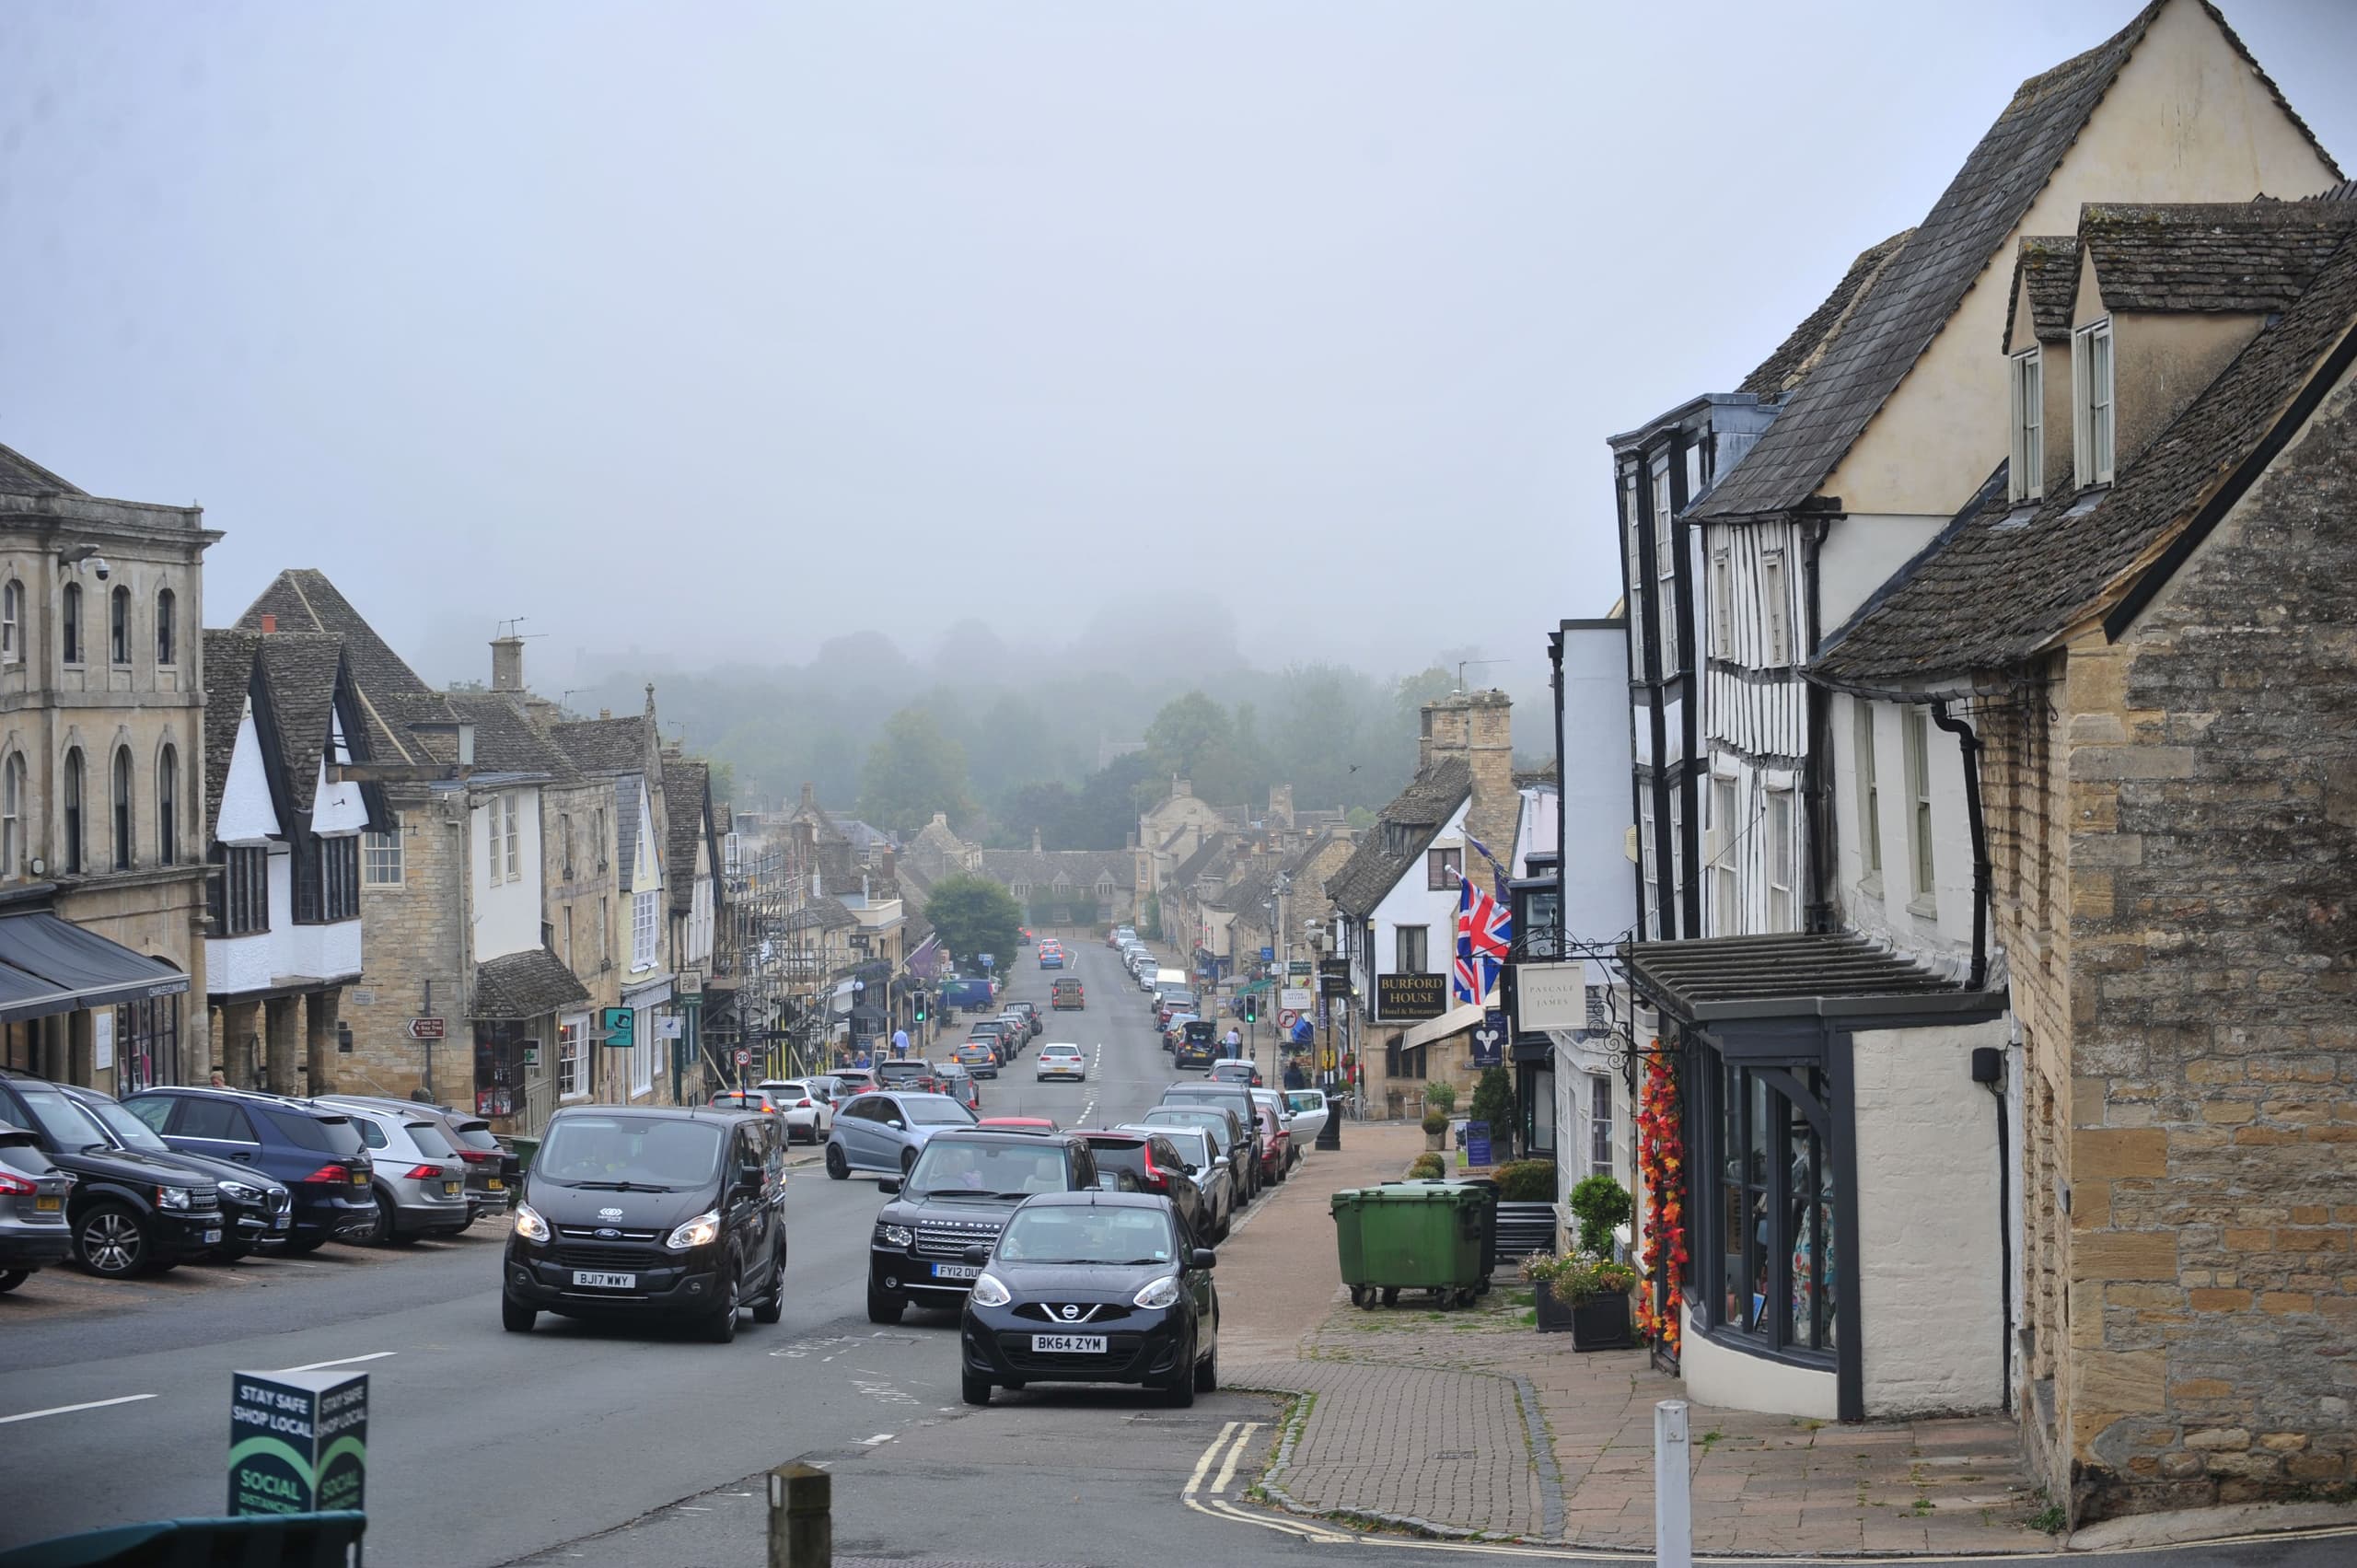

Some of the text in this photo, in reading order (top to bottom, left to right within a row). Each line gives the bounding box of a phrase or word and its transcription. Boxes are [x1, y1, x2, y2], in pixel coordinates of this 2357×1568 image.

[1381, 978, 1443, 990] BURFORD
[1390, 993, 1435, 1003] HOUSE
[1537, 998, 1569, 1007] JAMES
[737, 1053, 749, 1062] 20
[940, 1266, 962, 1277] FY12
[579, 1273, 605, 1285] BJ17
[1038, 1337, 1101, 1350] BK64 ZYM
[240, 1385, 309, 1415] STAY SAFE
[321, 1385, 365, 1415] STAY SAFE
[232, 1405, 314, 1439] SHOP LOCAL
[317, 1406, 366, 1438] SHOP LOCAL
[239, 1469, 301, 1502] SOCIAL
